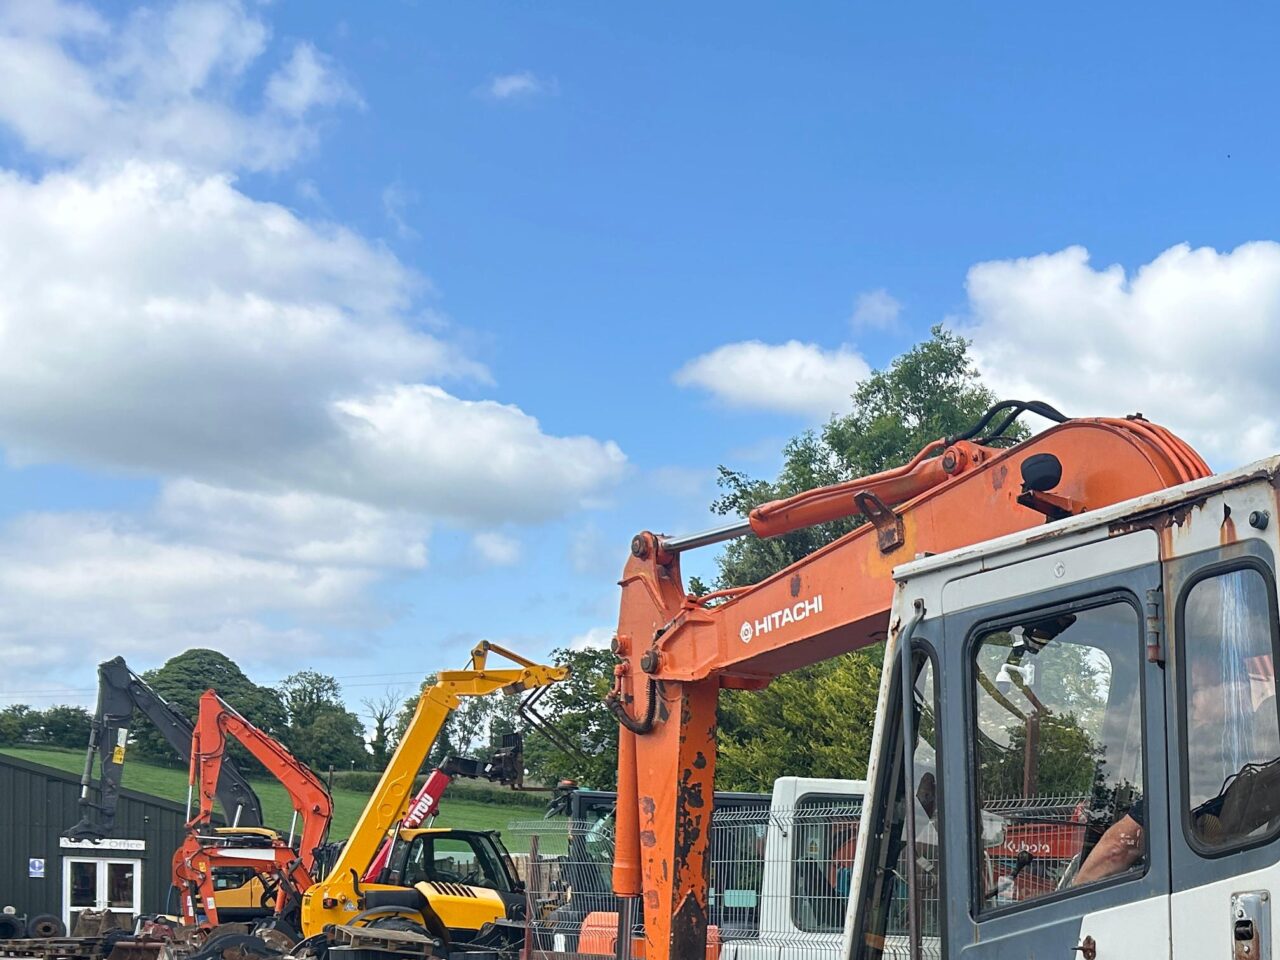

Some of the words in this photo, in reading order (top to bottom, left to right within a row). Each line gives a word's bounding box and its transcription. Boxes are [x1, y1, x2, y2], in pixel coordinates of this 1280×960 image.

[754, 594, 823, 636] HITACHI
[109, 841, 142, 849] Office
[1004, 840, 1050, 853] Kubota
